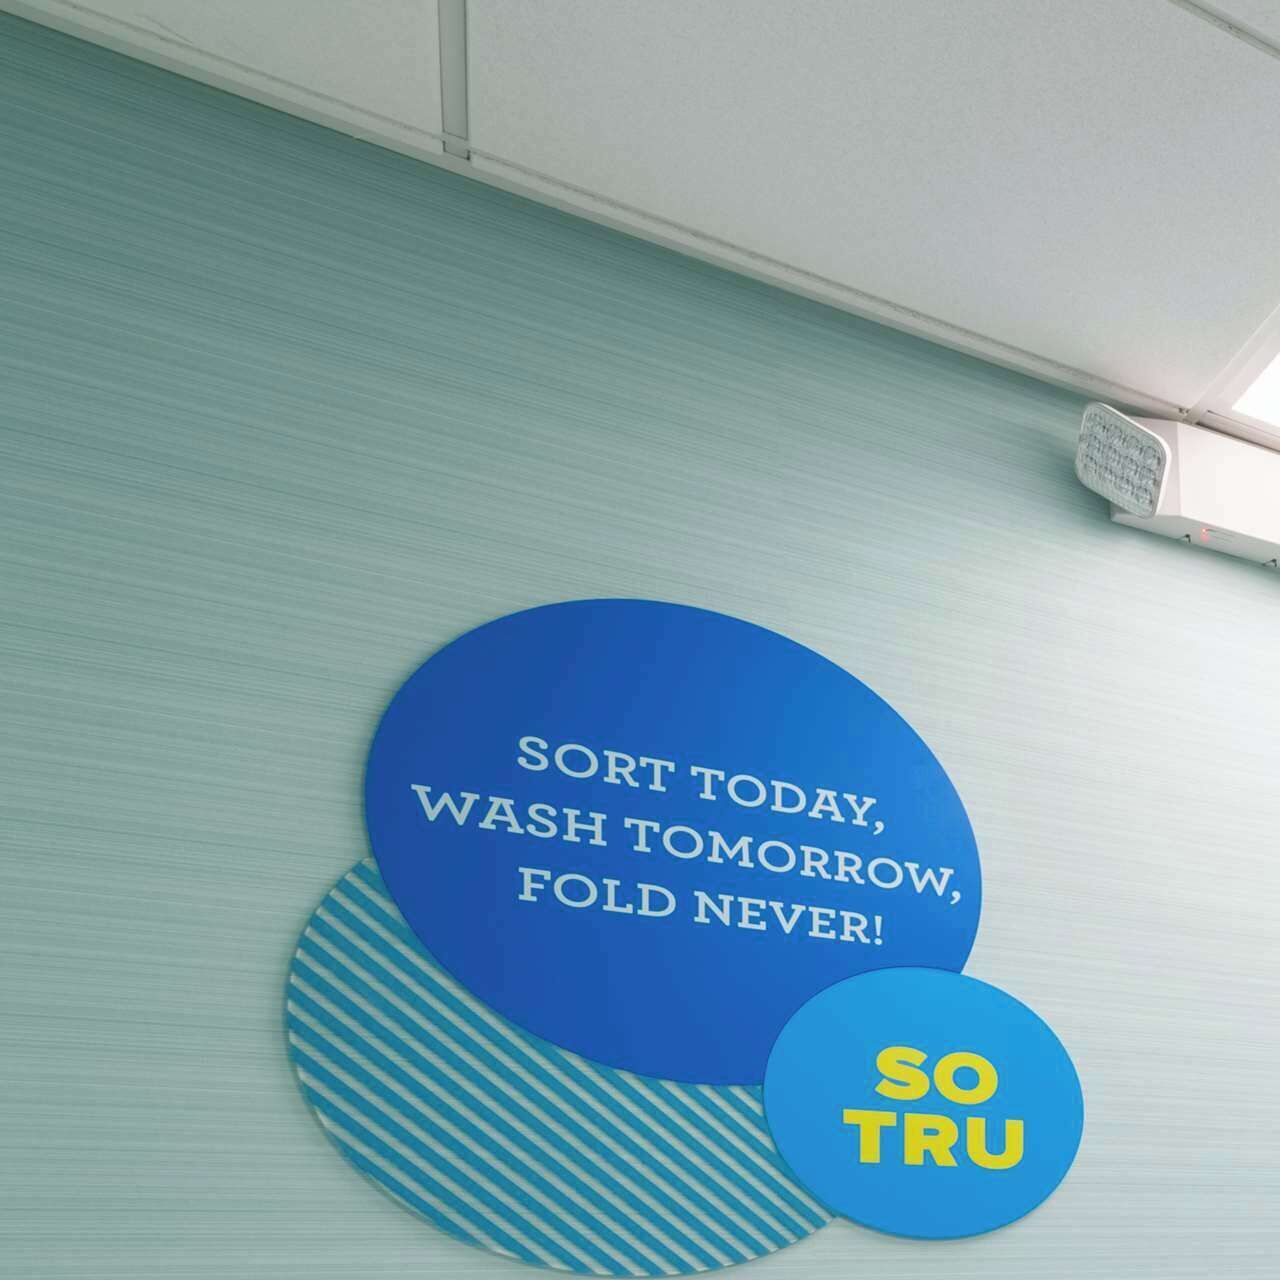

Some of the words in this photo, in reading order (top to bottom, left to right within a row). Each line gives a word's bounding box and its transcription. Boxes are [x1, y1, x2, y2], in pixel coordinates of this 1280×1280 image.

[516, 735, 676, 793] SORT
[690, 765, 886, 836] TODAY,
[410, 783, 607, 848] WASH
[623, 817, 963, 906] TOMORROW,
[517, 866, 678, 920] FOLD
[692, 893, 885, 947] NEVER!
[874, 1045, 999, 1106] SO
[843, 1109, 1025, 1171] TRU
